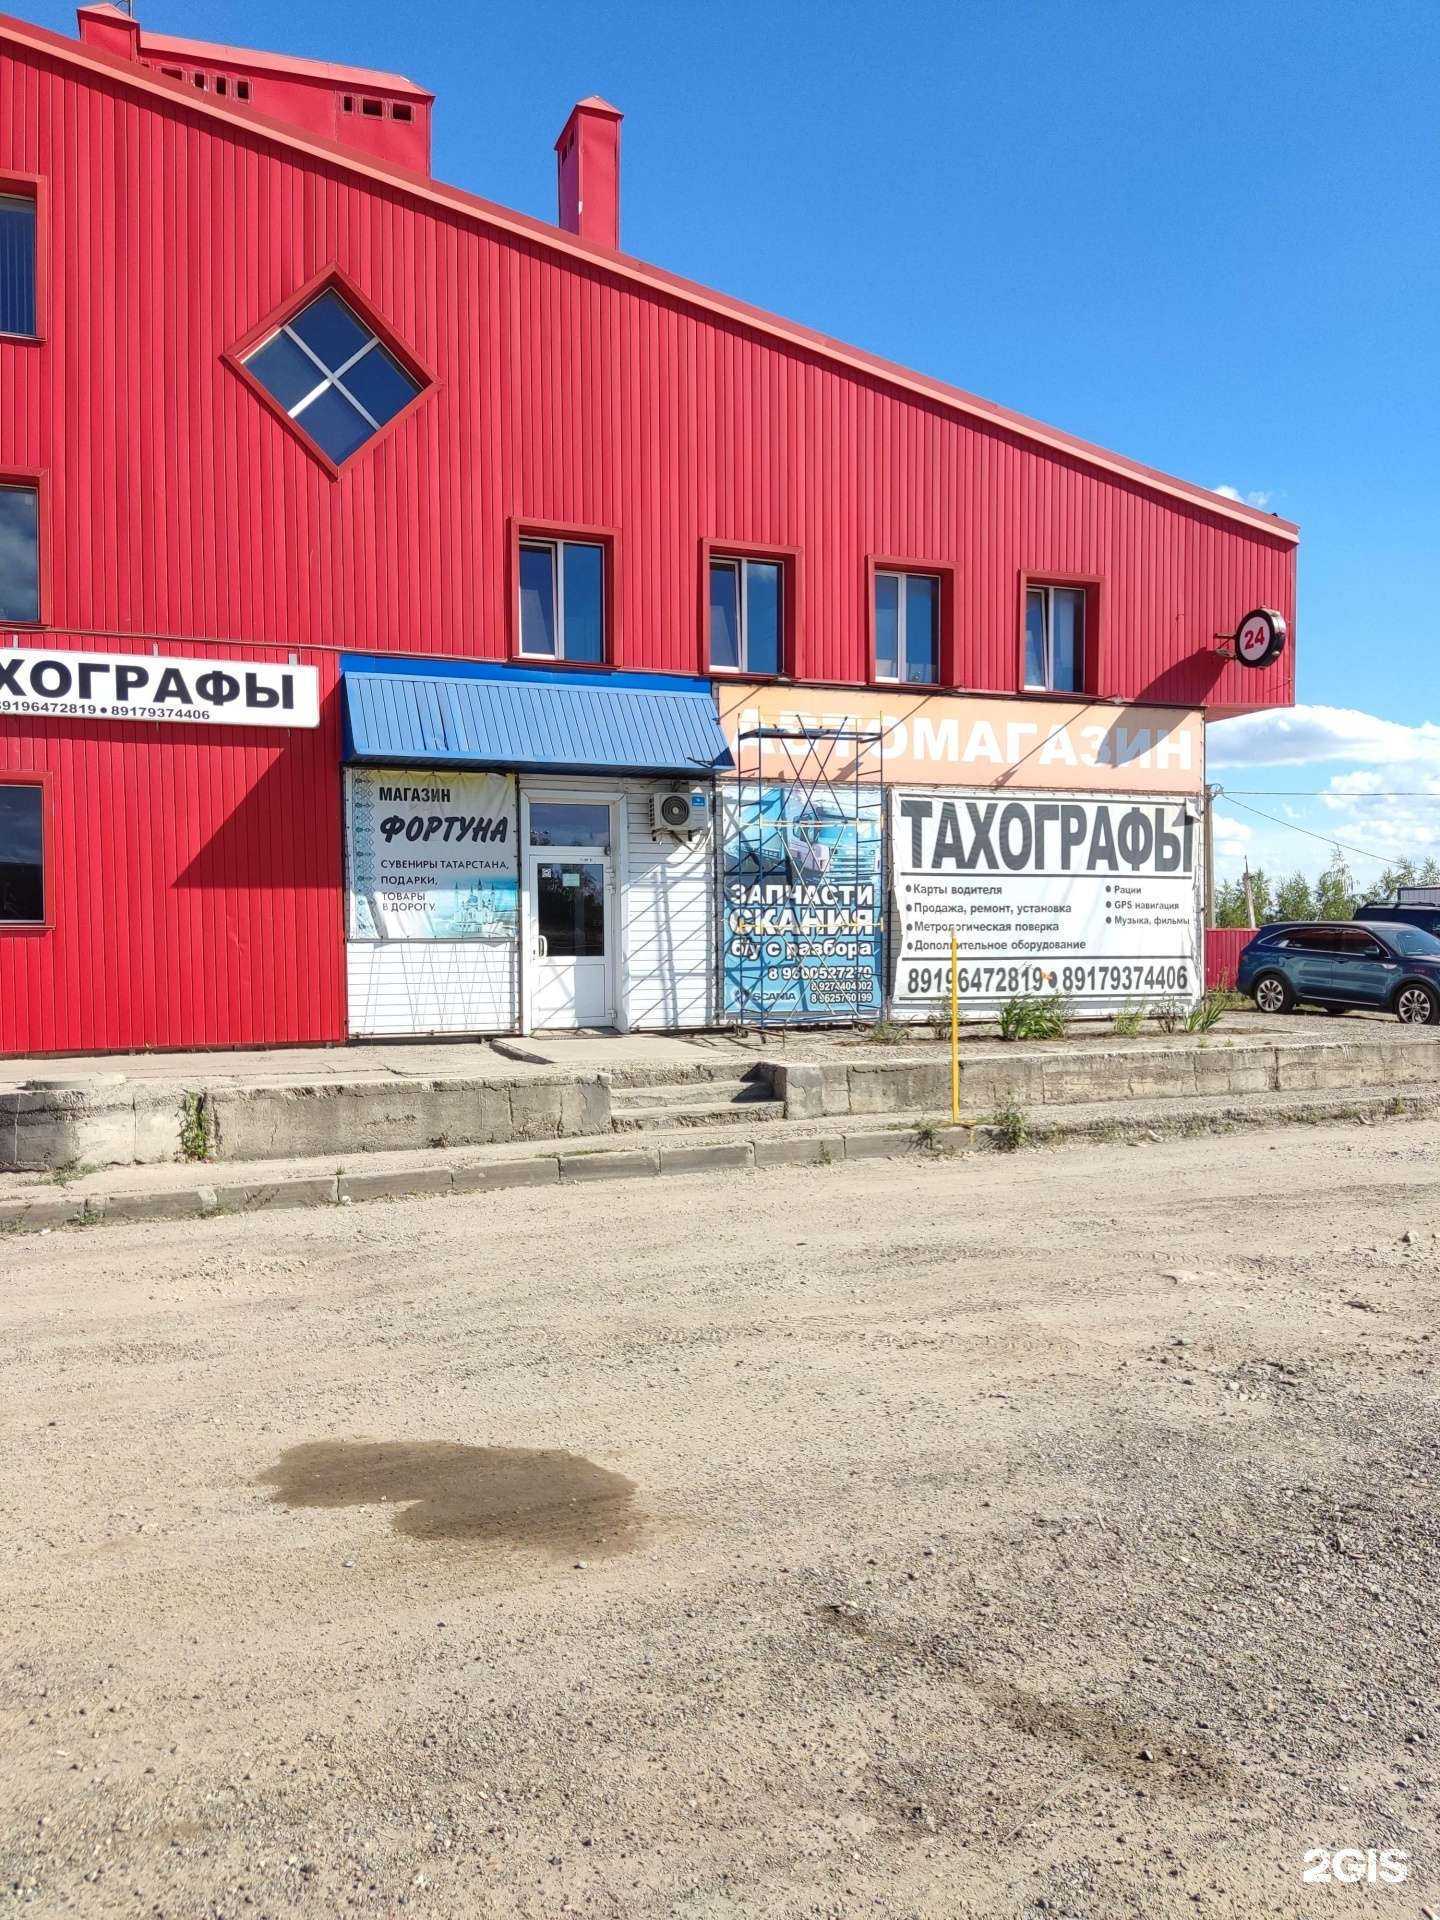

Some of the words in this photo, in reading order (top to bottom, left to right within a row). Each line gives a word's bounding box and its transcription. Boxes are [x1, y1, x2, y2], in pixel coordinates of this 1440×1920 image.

[1244, 626, 1265, 650] 24
[0, 658, 294, 710] ХОГРАФЫ
[0, 700, 97, 715] 9196472819
[110, 706, 211, 720] 89179374406
[731, 707, 1192, 770] АВТОМАГАЗИН
[379, 787, 450, 802] МАГАЗИН
[379, 815, 509, 843] ФОРТУНА
[901, 800, 1193, 873] ТАХОГРАФЫ
[381, 859, 438, 869] СУВЕНИРЫ
[440, 860, 510, 870] ТАТАРСТАНА,
[381, 876, 440, 886] ПОДАРКИ,
[730, 883, 874, 906] ЗАПЧАСТИ
[913, 883, 948, 896] Карты
[951, 885, 1002, 896] водителя
[1114, 885, 1142, 895] Рации
[382, 892, 426, 901] ТОВАРЫ
[382, 902, 389, 911] В
[914, 902, 967, 915] Продажа,
[970, 904, 1014, 915] ремонт,
[1016, 904, 1072, 915] установка
[1114, 900, 1132, 910] GPS
[1134, 902, 1180, 912] навигация
[729, 907, 874, 936] СКАНИЯ
[914, 921, 1012, 933] Метрологическая
[1015, 922, 1059, 932] поверка
[1114, 915, 1151, 926] Музыка,
[1153, 916, 1190, 926] фильмы
[766, 942, 781, 956] с
[785, 938, 873, 960] разбора
[914, 939, 1007, 952] Дополительное
[1011, 940, 1086, 952] оборудование
[768, 967, 779, 980] 8
[907, 966, 1043, 994] 89196472819
[1062, 966, 1188, 991] 89179374406
